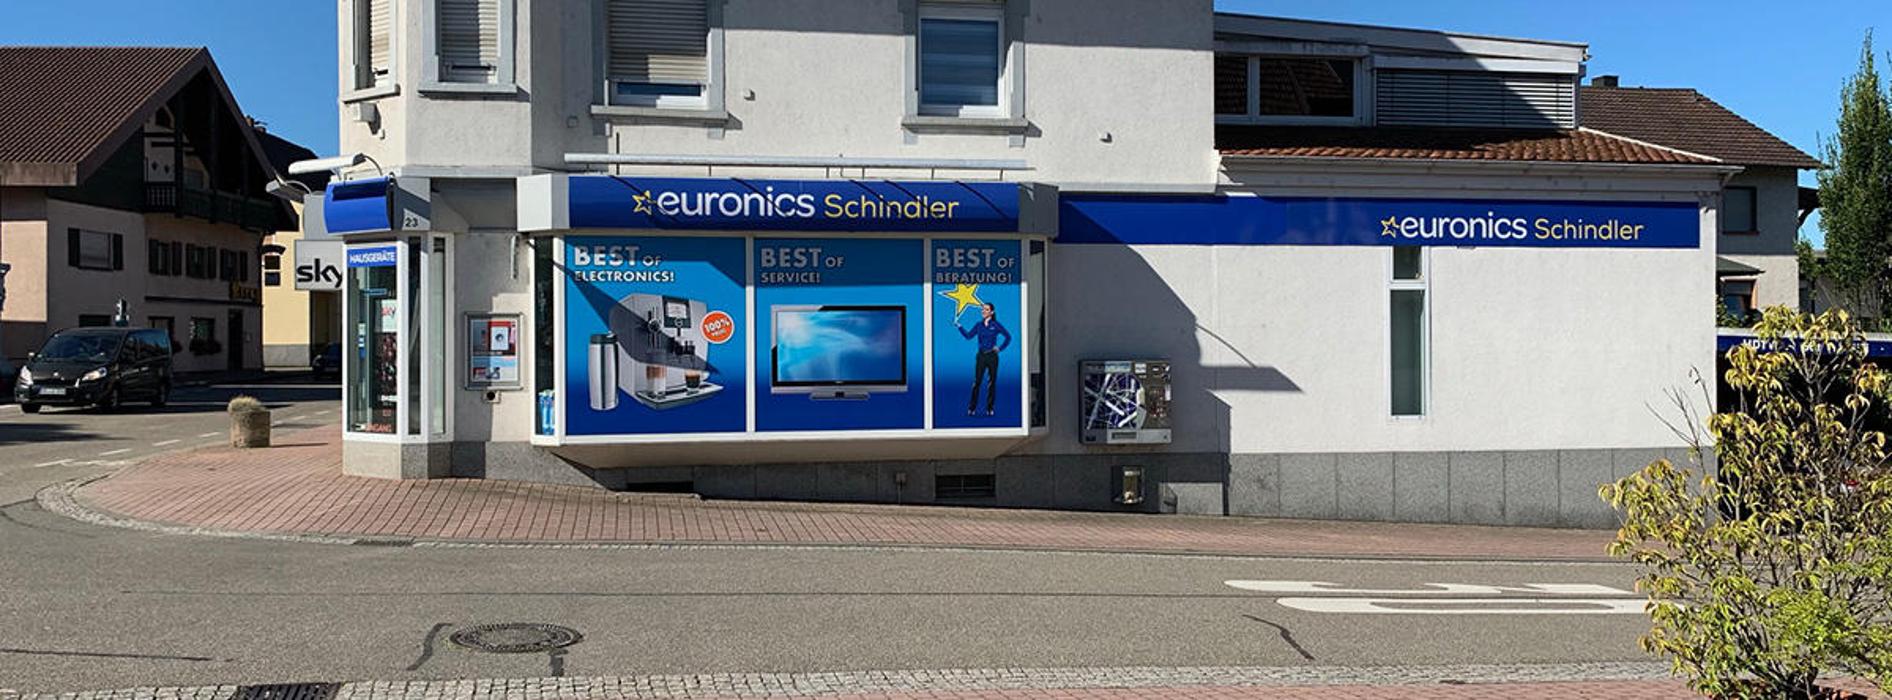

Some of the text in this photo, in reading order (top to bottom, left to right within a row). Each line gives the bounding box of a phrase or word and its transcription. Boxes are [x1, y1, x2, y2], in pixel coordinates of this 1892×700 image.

[656, 187, 960, 219] euronics Schindler
[404, 216, 419, 228] 23
[1400, 211, 1645, 240] euronics Schindler
[349, 250, 395, 264] HAUSGERÄTE
[574, 245, 662, 267] BEST OF
[760, 247, 845, 268] BEST OF
[935, 248, 1015, 269] BEST OF
[296, 257, 342, 288] sky
[574, 270, 675, 282] ELECTRONICS!
[760, 272, 821, 284] SERVICE!
[935, 272, 1012, 284] BERATUNG!
[704, 318, 731, 333] 100%
